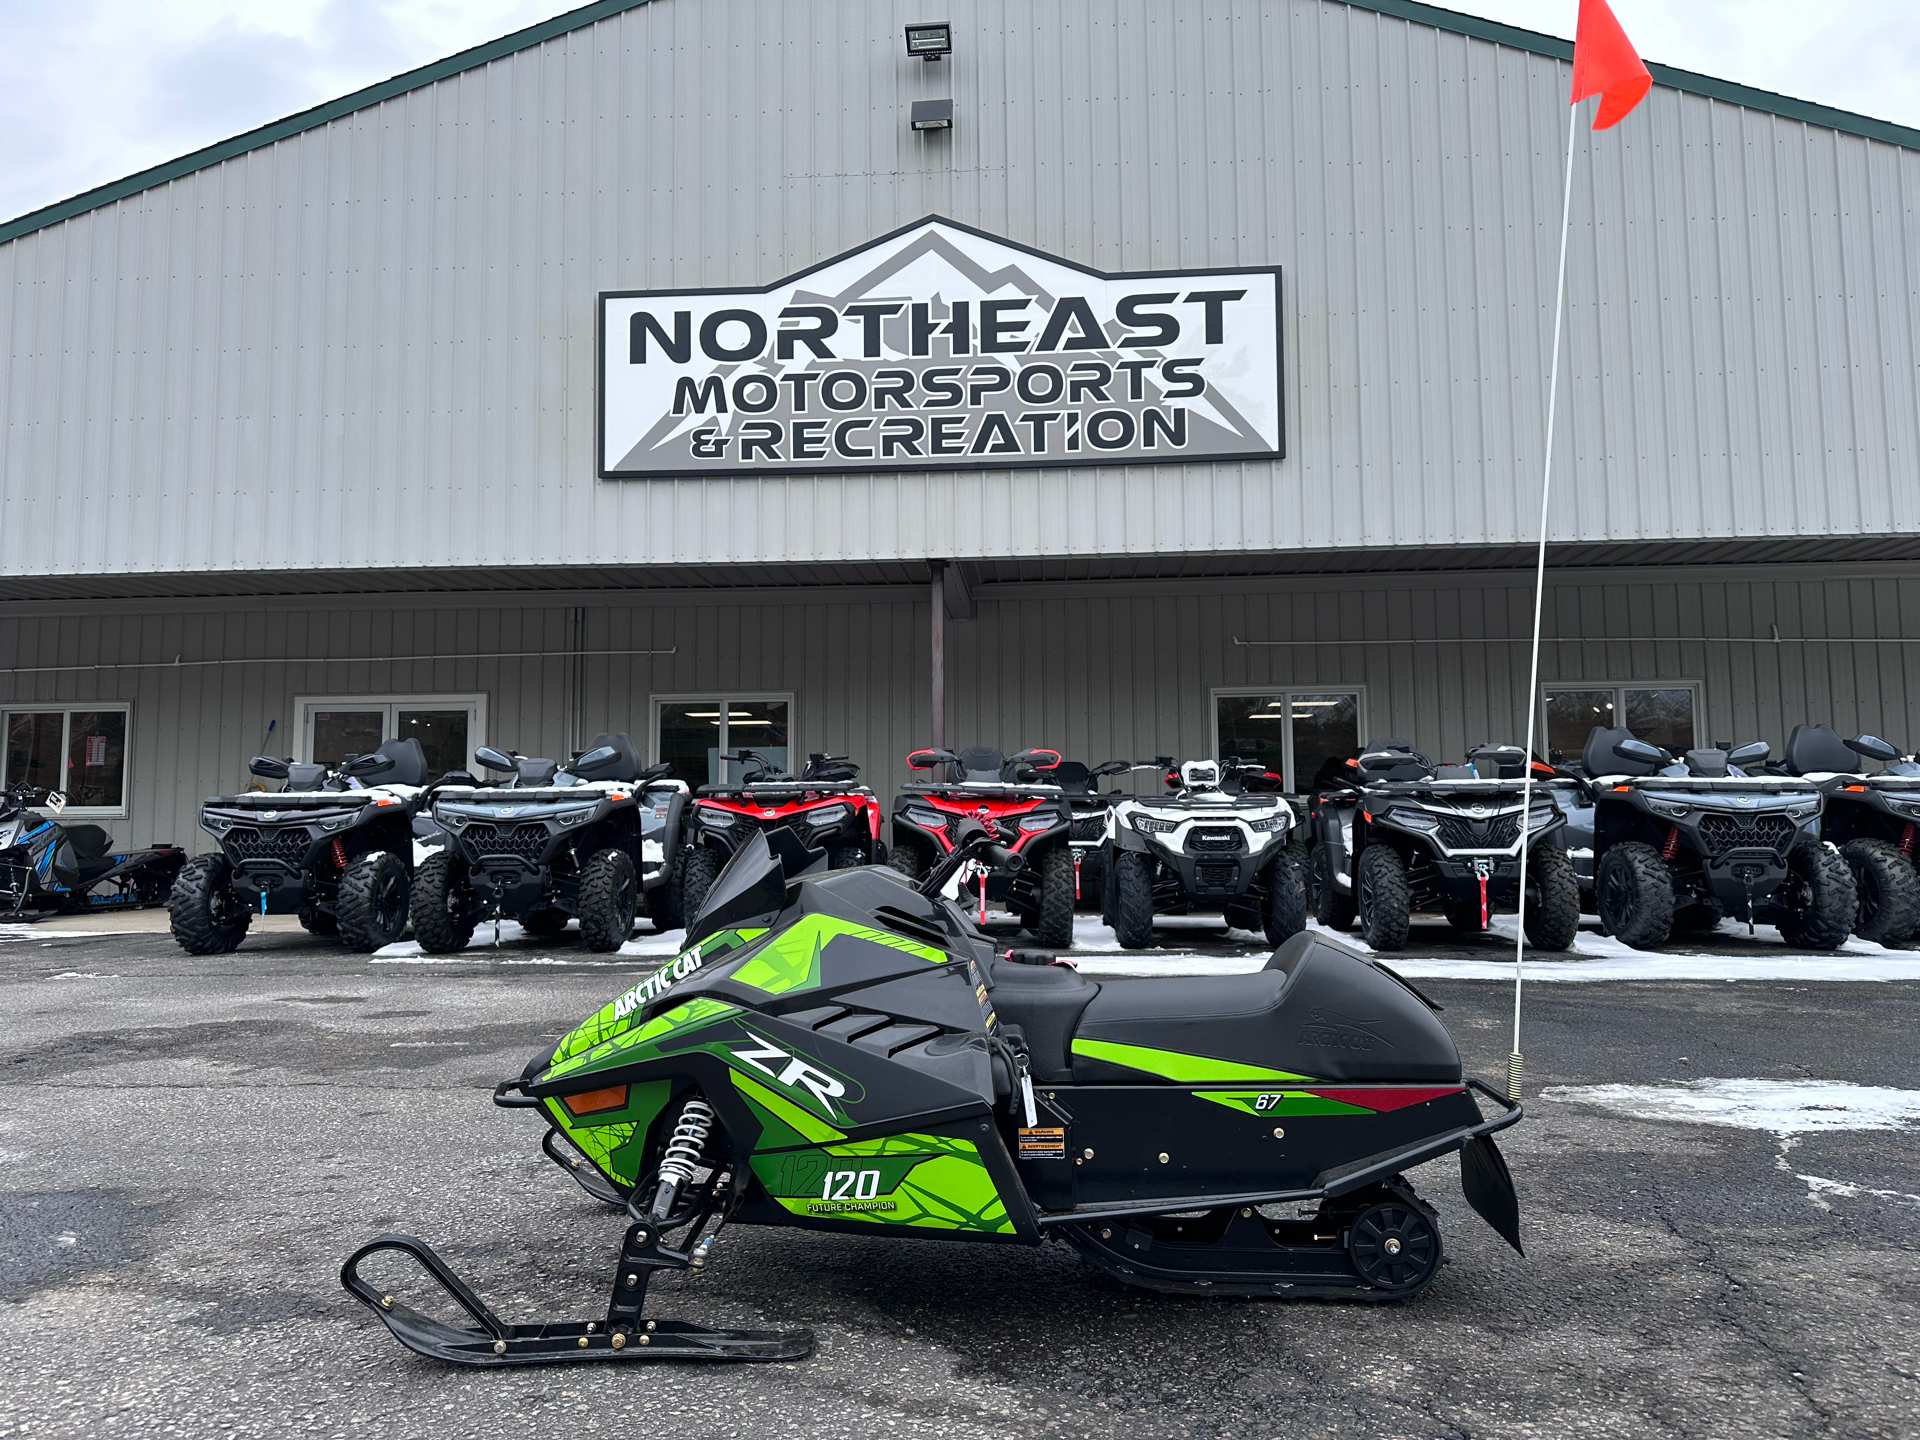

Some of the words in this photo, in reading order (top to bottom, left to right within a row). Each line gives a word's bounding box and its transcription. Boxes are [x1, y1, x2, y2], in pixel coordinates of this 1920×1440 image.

[629, 289, 1248, 364] NORTHEAST
[672, 357, 1206, 415] MOTORSPORTS
[741, 407, 1187, 461] RECREATION
[614, 966, 671, 1021] ARCTIC
[673, 946, 702, 979] CAT
[729, 1030, 845, 1121] ZR
[1255, 1094, 1283, 1110] 67
[806, 1202, 843, 1213] FUTURE
[844, 1200, 895, 1212] CHAMPION
[822, 1169, 880, 1200] 120
